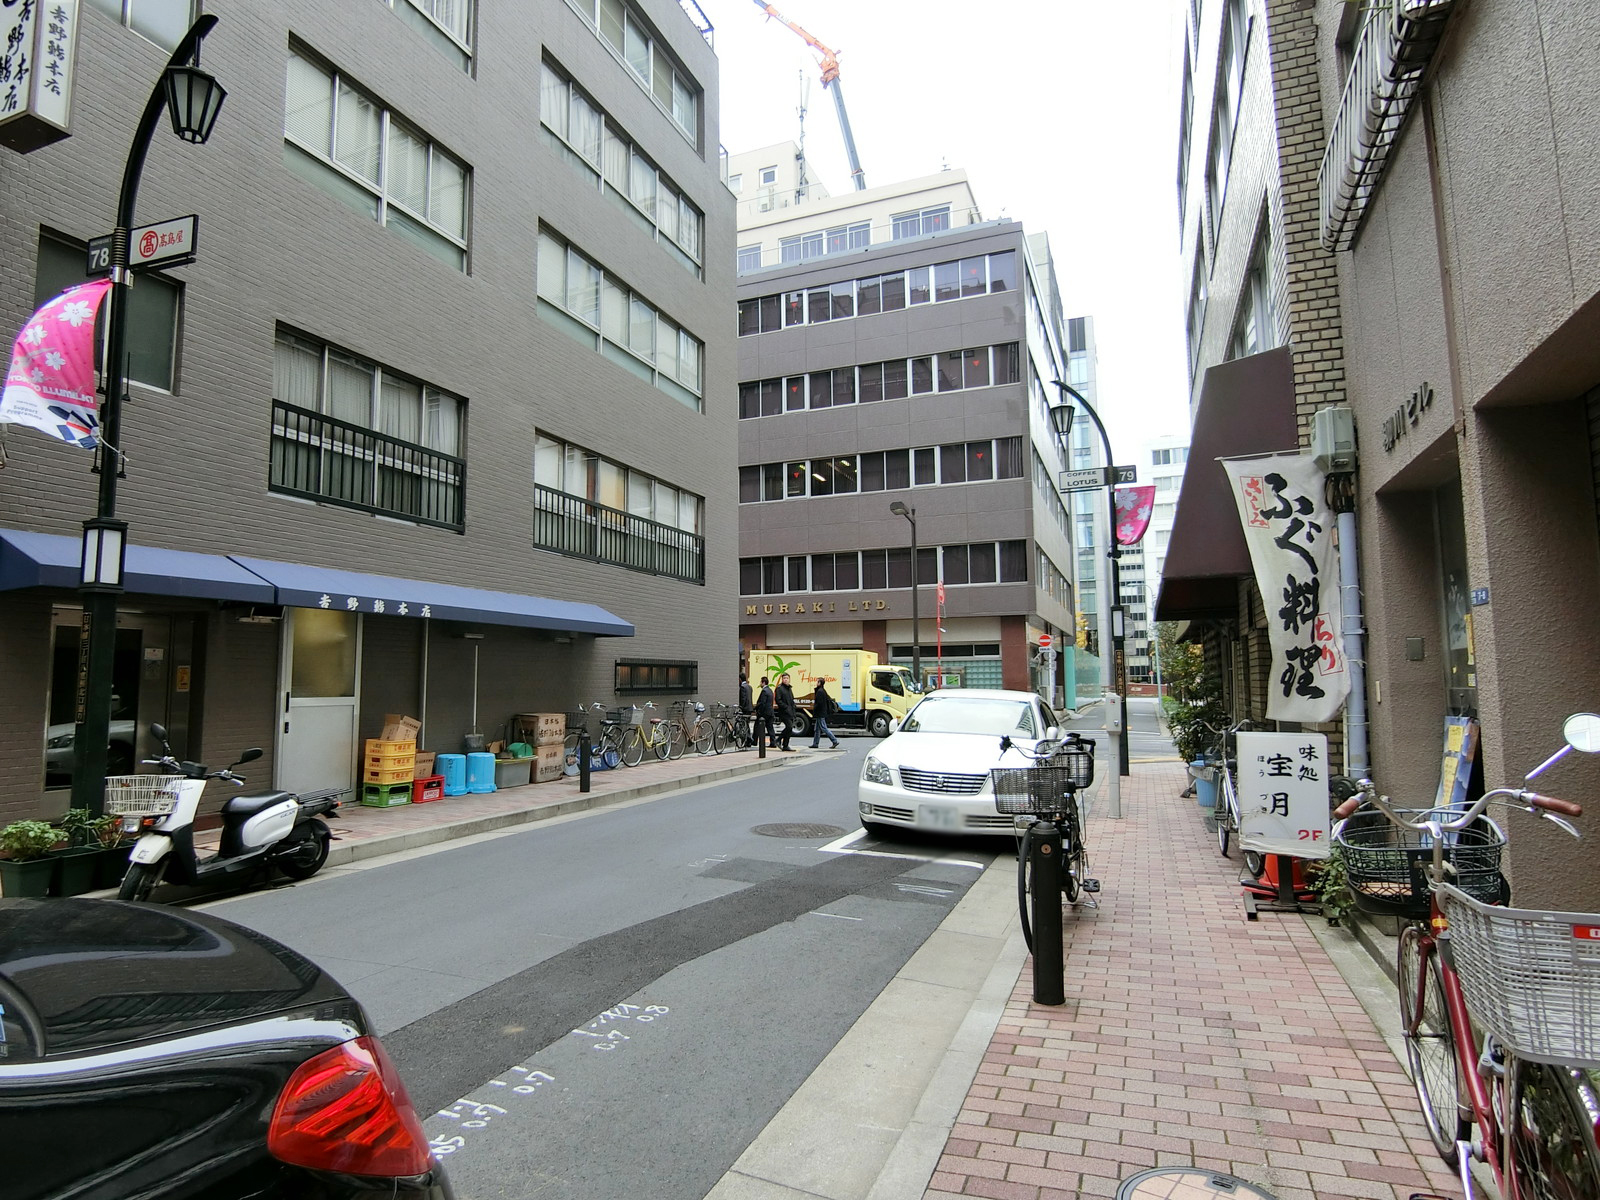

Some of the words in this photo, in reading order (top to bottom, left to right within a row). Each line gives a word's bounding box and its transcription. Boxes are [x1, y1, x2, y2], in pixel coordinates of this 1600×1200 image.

[90, 247, 110, 269] 78
[1066, 470, 1098, 478] COFFEE
[1066, 478, 1098, 487] LOTUS
[1119, 471, 1135, 482] 79
[1260, 472, 1326, 700] ふぐ料理
[746, 601, 835, 616] MURAKI
[848, 599, 891, 612] LTD.
[1314, 616, 1337, 672] ちり
[801, 671, 838, 684] Hawiian
[1297, 743, 1320, 782] 味処
[1266, 752, 1294, 818] 宝月
[1297, 829, 1323, 841] 2F
